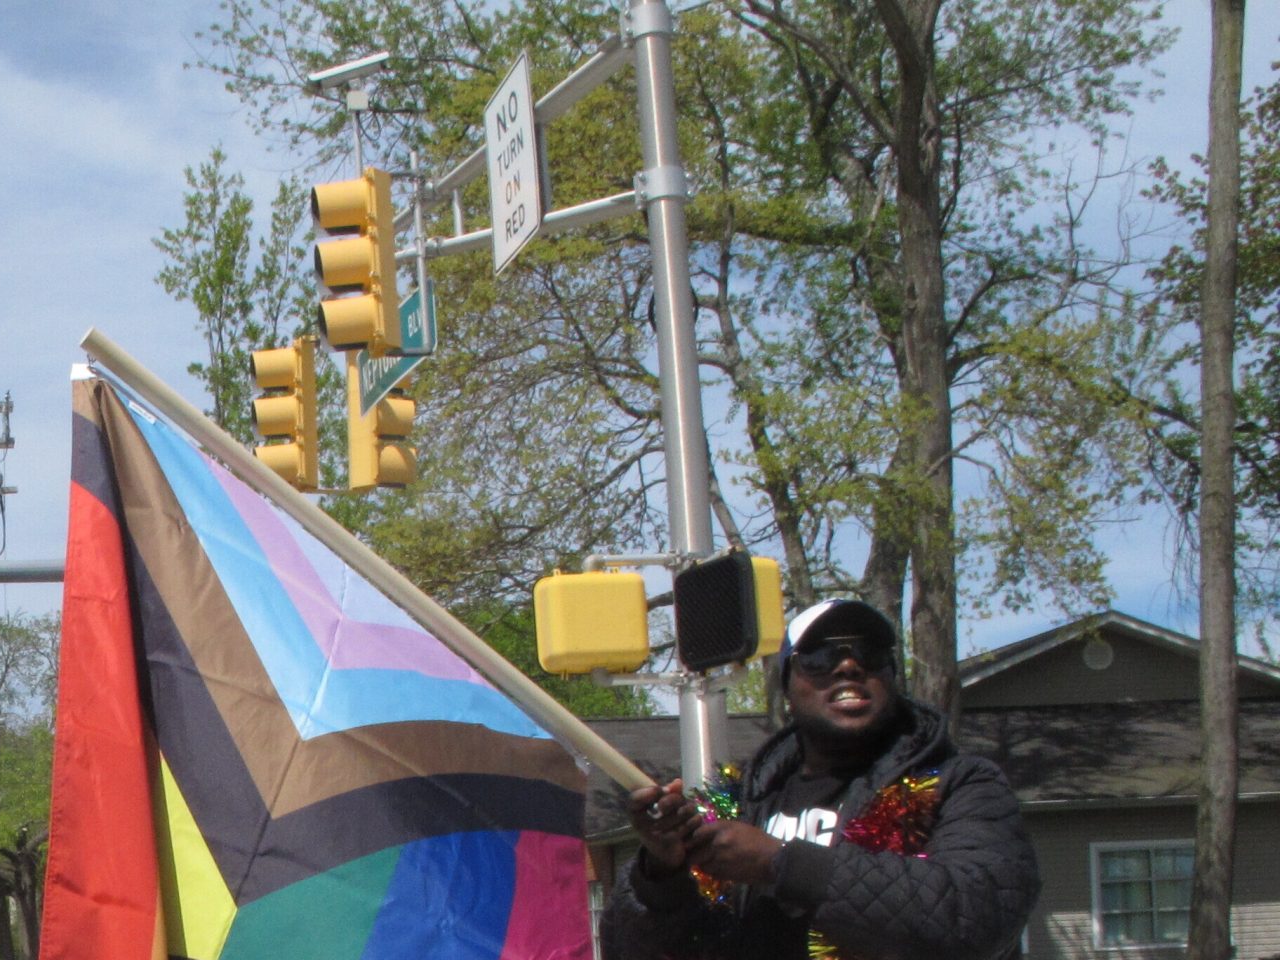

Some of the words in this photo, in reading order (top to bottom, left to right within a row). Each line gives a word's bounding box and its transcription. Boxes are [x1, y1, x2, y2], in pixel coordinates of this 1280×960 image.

[496, 91, 518, 141] NO
[497, 128, 524, 177] TURN
[505, 170, 521, 205] ON
[505, 204, 526, 243] RED
